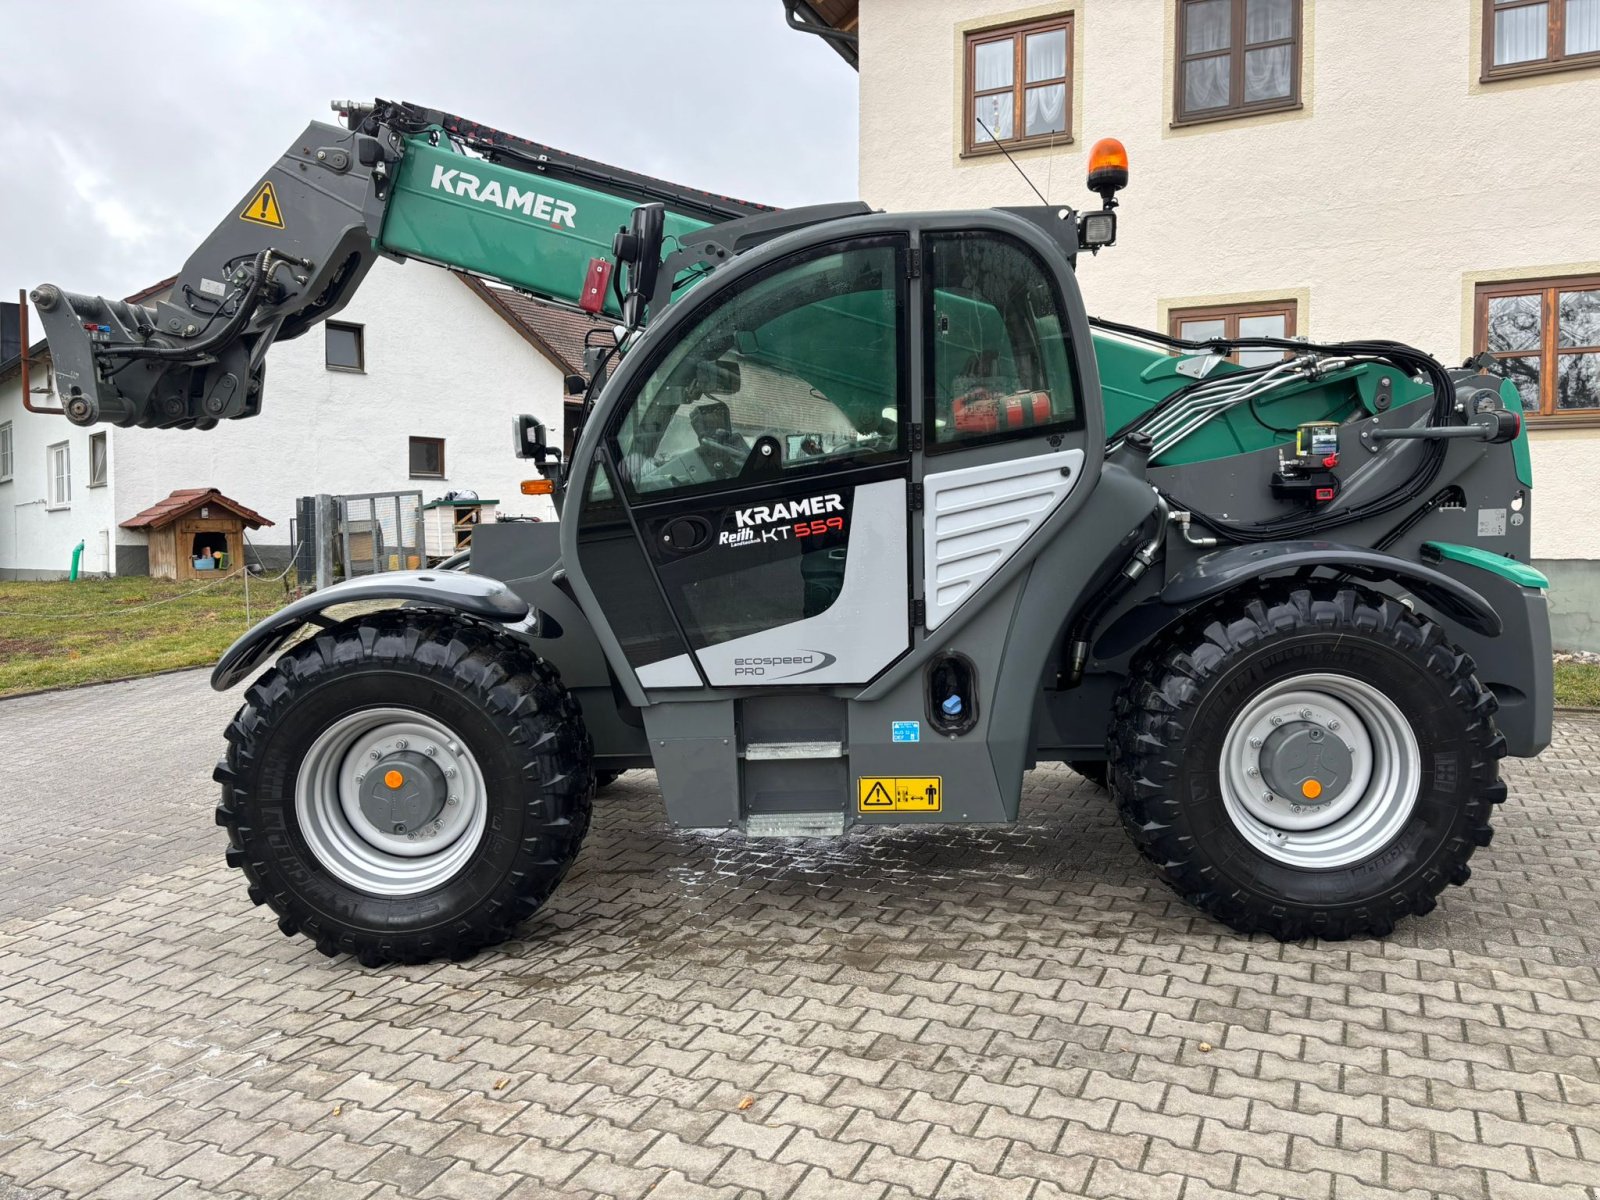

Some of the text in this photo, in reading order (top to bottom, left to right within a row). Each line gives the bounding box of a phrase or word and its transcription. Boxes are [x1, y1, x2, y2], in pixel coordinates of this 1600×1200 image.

[431, 164, 577, 228] KRAMER
[735, 493, 845, 528] KRAMER
[719, 527, 754, 545] Reith
[735, 655, 813, 666] ecospeed
[735, 667, 765, 676] PRO
